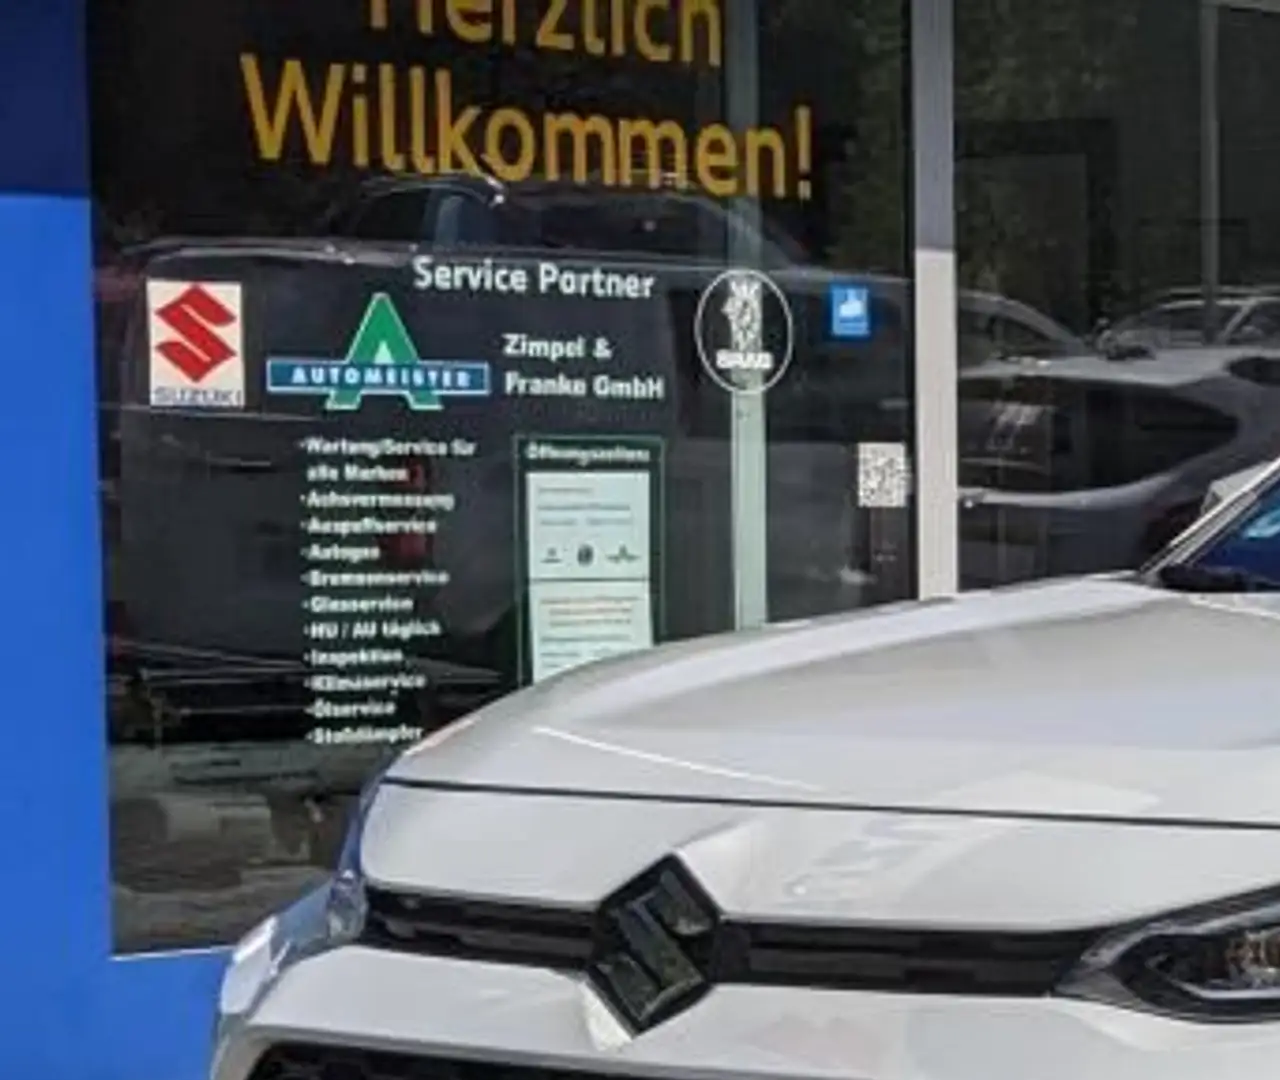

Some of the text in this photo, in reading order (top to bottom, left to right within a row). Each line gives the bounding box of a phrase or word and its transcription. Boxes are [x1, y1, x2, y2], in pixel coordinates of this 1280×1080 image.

[370, 0, 722, 67] erzlich
[239, 53, 813, 200] Willkommen!
[413, 256, 657, 299] Service Partner
[504, 333, 612, 360] Zimpel &
[291, 366, 470, 387] AUTOMEISTER
[504, 373, 665, 399] Franke GmbH
[152, 387, 242, 405] SUZUKI
